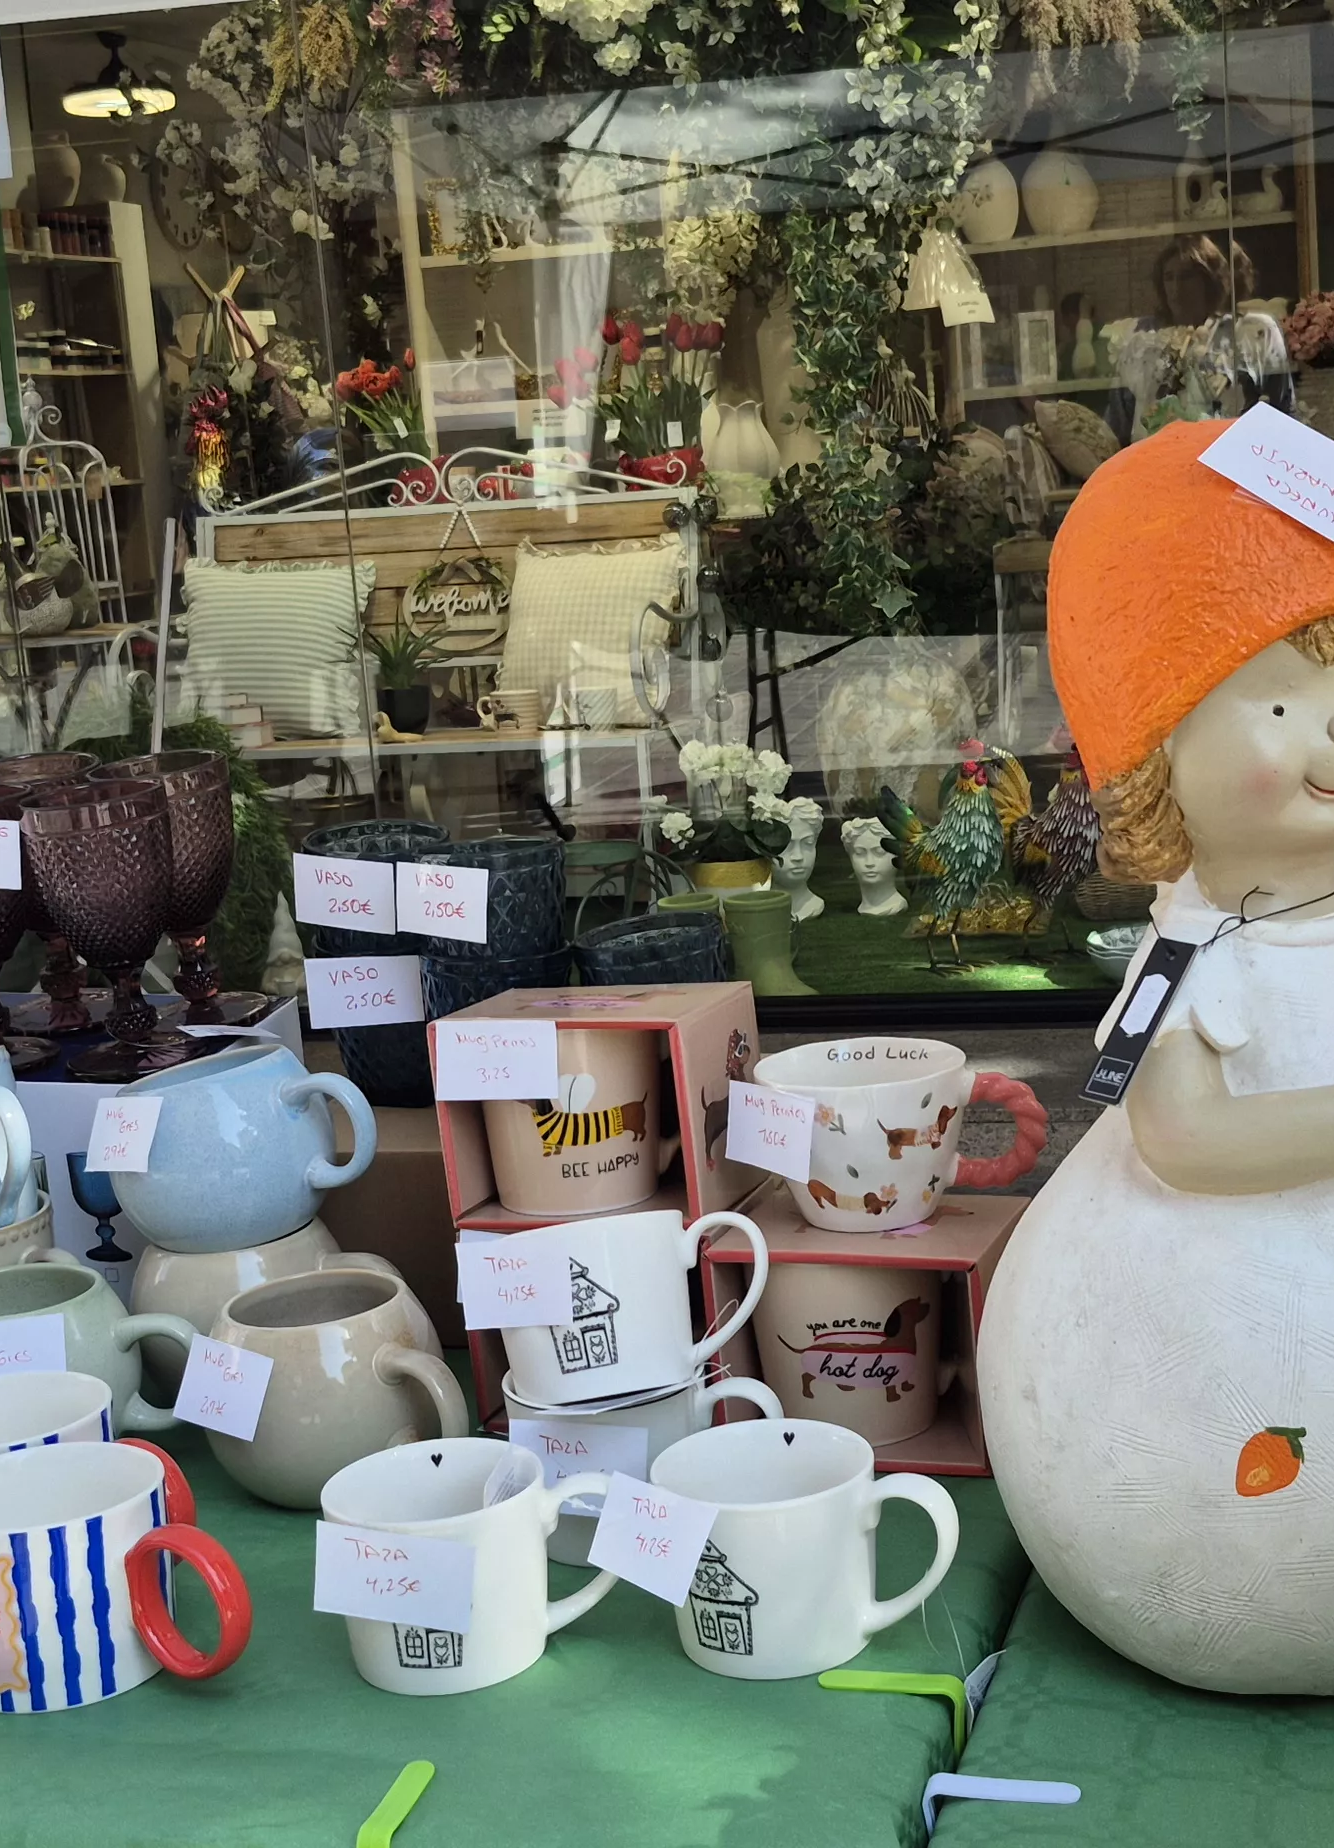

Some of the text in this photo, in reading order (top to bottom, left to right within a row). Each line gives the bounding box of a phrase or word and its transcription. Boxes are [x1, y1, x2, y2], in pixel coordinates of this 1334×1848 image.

[410, 586, 510, 618] welcome
[315, 869, 353, 887] VASO
[416, 872, 454, 889] VASO
[329, 898, 375, 915] 2,50€
[424, 900, 466, 919] 2,50€
[329, 966, 378, 986] VASO
[345, 989, 396, 1010] 2,50€
[827, 1046, 928, 1062] Good Luck
[562, 1152, 640, 1179] BEE HAPPY
[806, 1318, 881, 1336] you are one
[820, 1353, 899, 1385] hot dog
